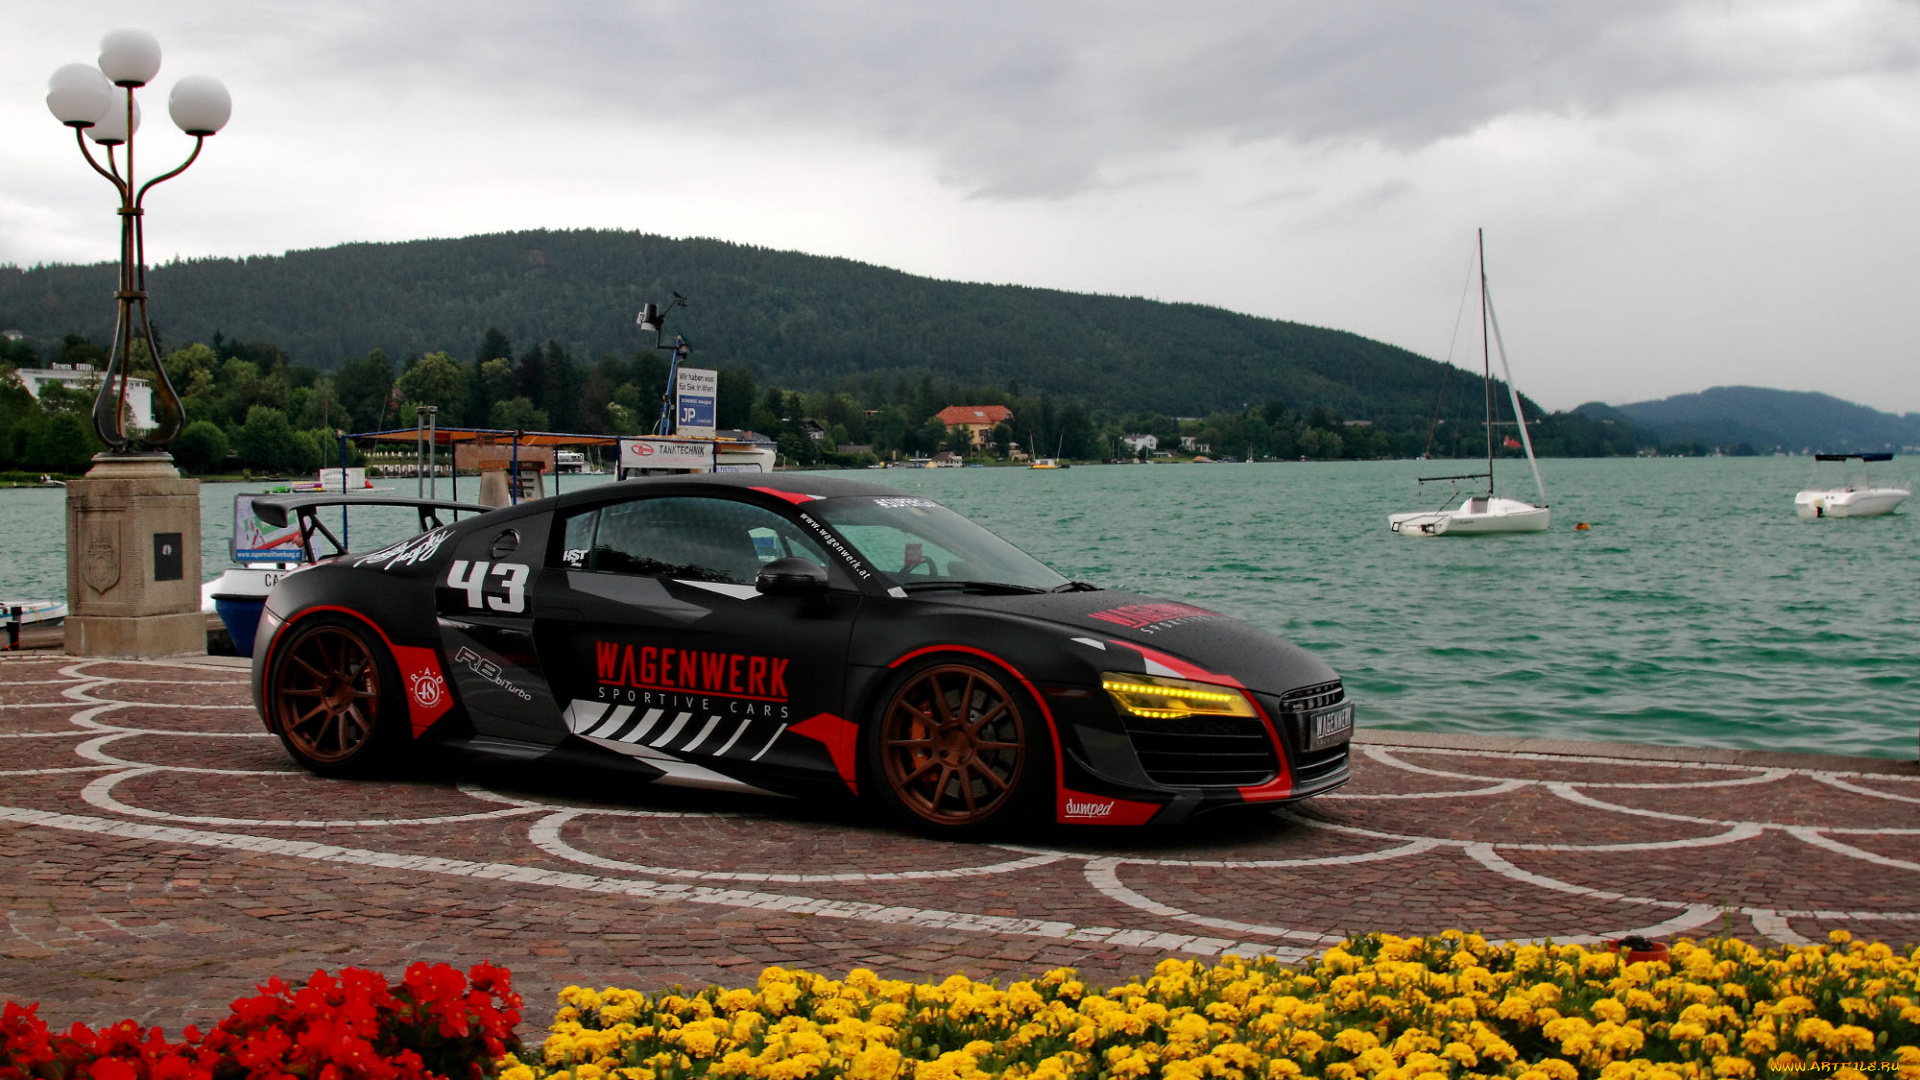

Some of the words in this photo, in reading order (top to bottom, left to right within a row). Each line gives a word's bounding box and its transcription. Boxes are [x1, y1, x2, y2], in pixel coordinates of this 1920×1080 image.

[689, 374, 704, 382] haben
[681, 407, 696, 423] JP
[660, 444, 705, 457] TANKTECHNIK
[562, 549, 589, 562] HST
[800, 512, 872, 580] www.wagenwerk.at
[446, 559, 531, 614] 43
[455, 645, 503, 683] R8
[596, 641, 790, 703] WAGENWERK
[418, 681, 436, 701] 48
[598, 687, 710, 710] SPORTIVE
[729, 701, 789, 718] CARS
[1064, 798, 1115, 818] dumped
